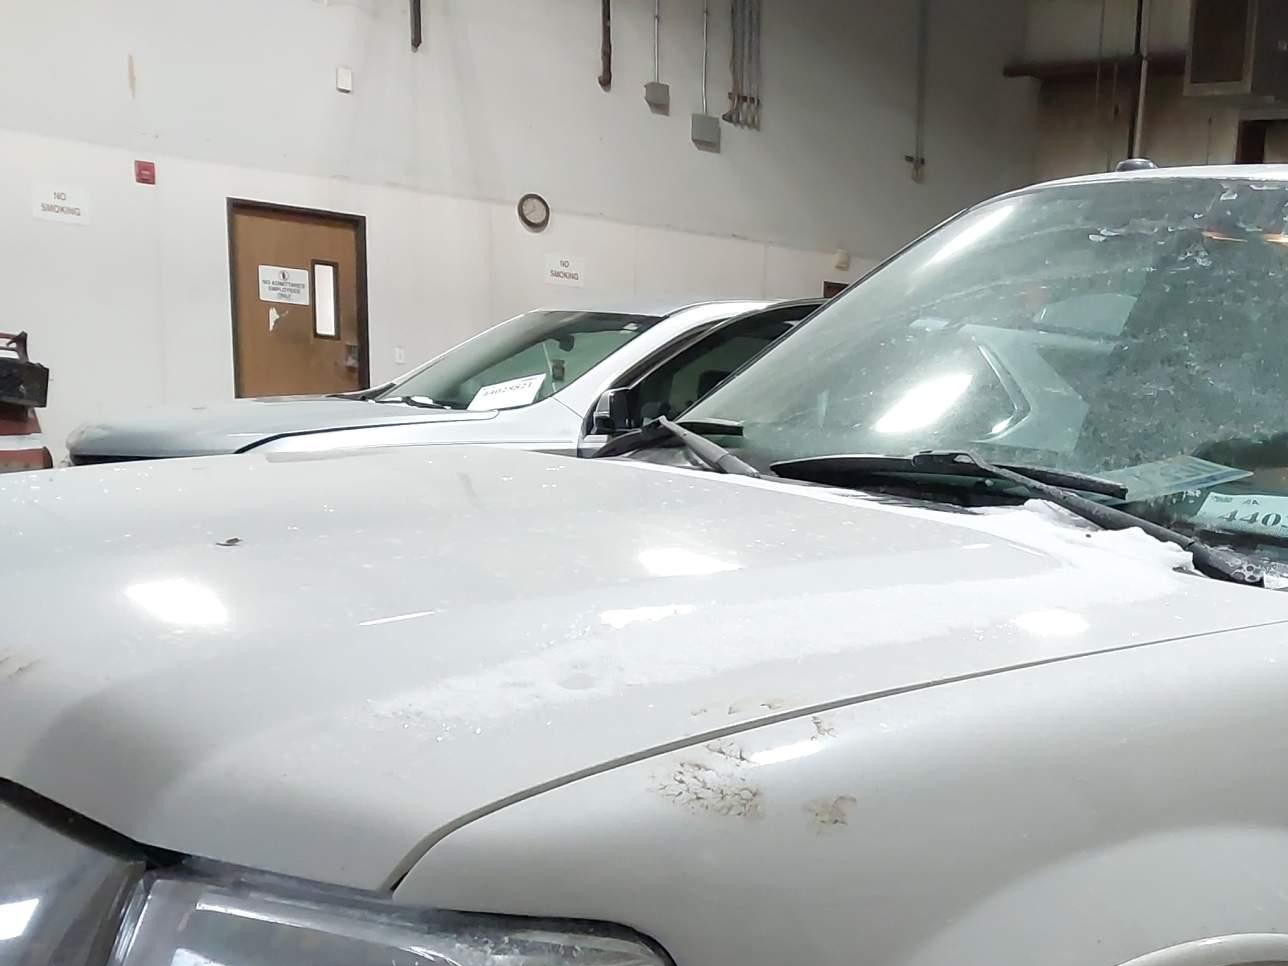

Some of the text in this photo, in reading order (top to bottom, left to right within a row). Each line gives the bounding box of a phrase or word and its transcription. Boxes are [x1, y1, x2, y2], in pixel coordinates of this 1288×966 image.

[53, 191, 66, 201] NO
[40, 202, 81, 217] SMOKING
[559, 260, 570, 268] NO
[549, 269, 579, 281] SMOKING
